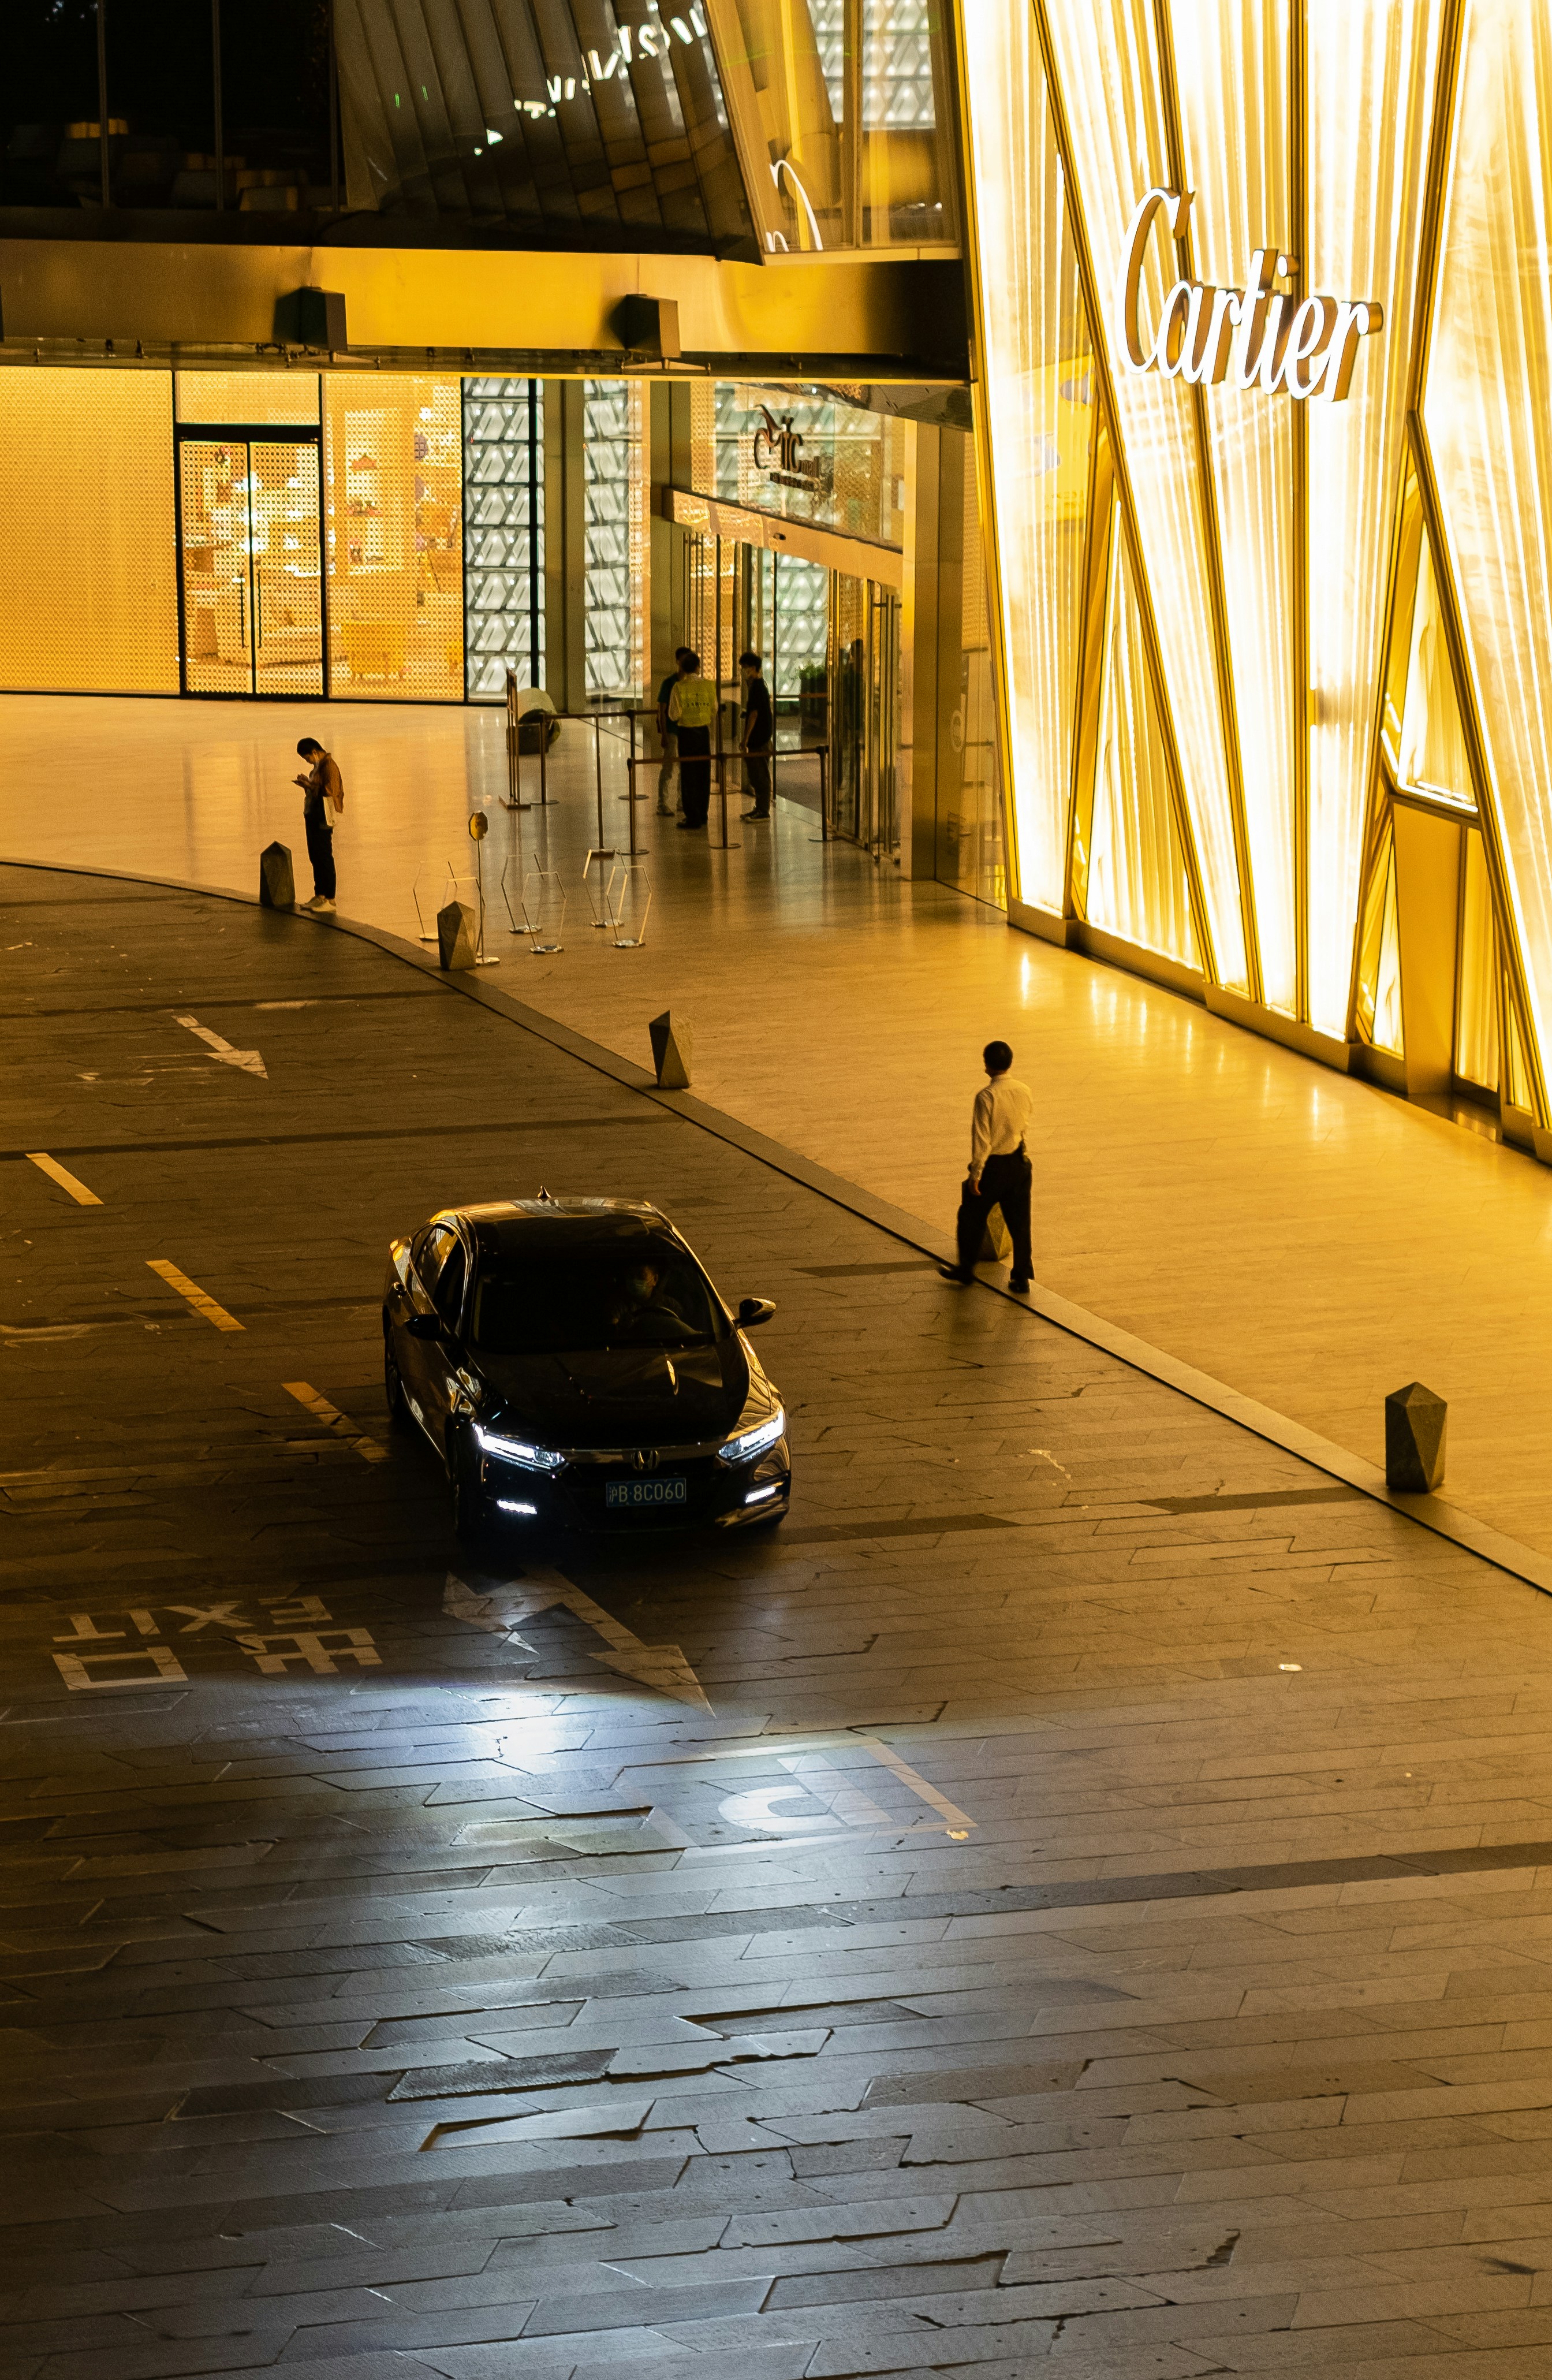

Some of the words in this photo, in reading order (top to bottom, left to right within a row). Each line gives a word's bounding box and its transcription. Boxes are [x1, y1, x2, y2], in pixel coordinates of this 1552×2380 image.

[1116, 187, 1383, 402] Cartier
[53, 1595, 333, 1642] EXIT
[51, 1627, 383, 1690] 出口
